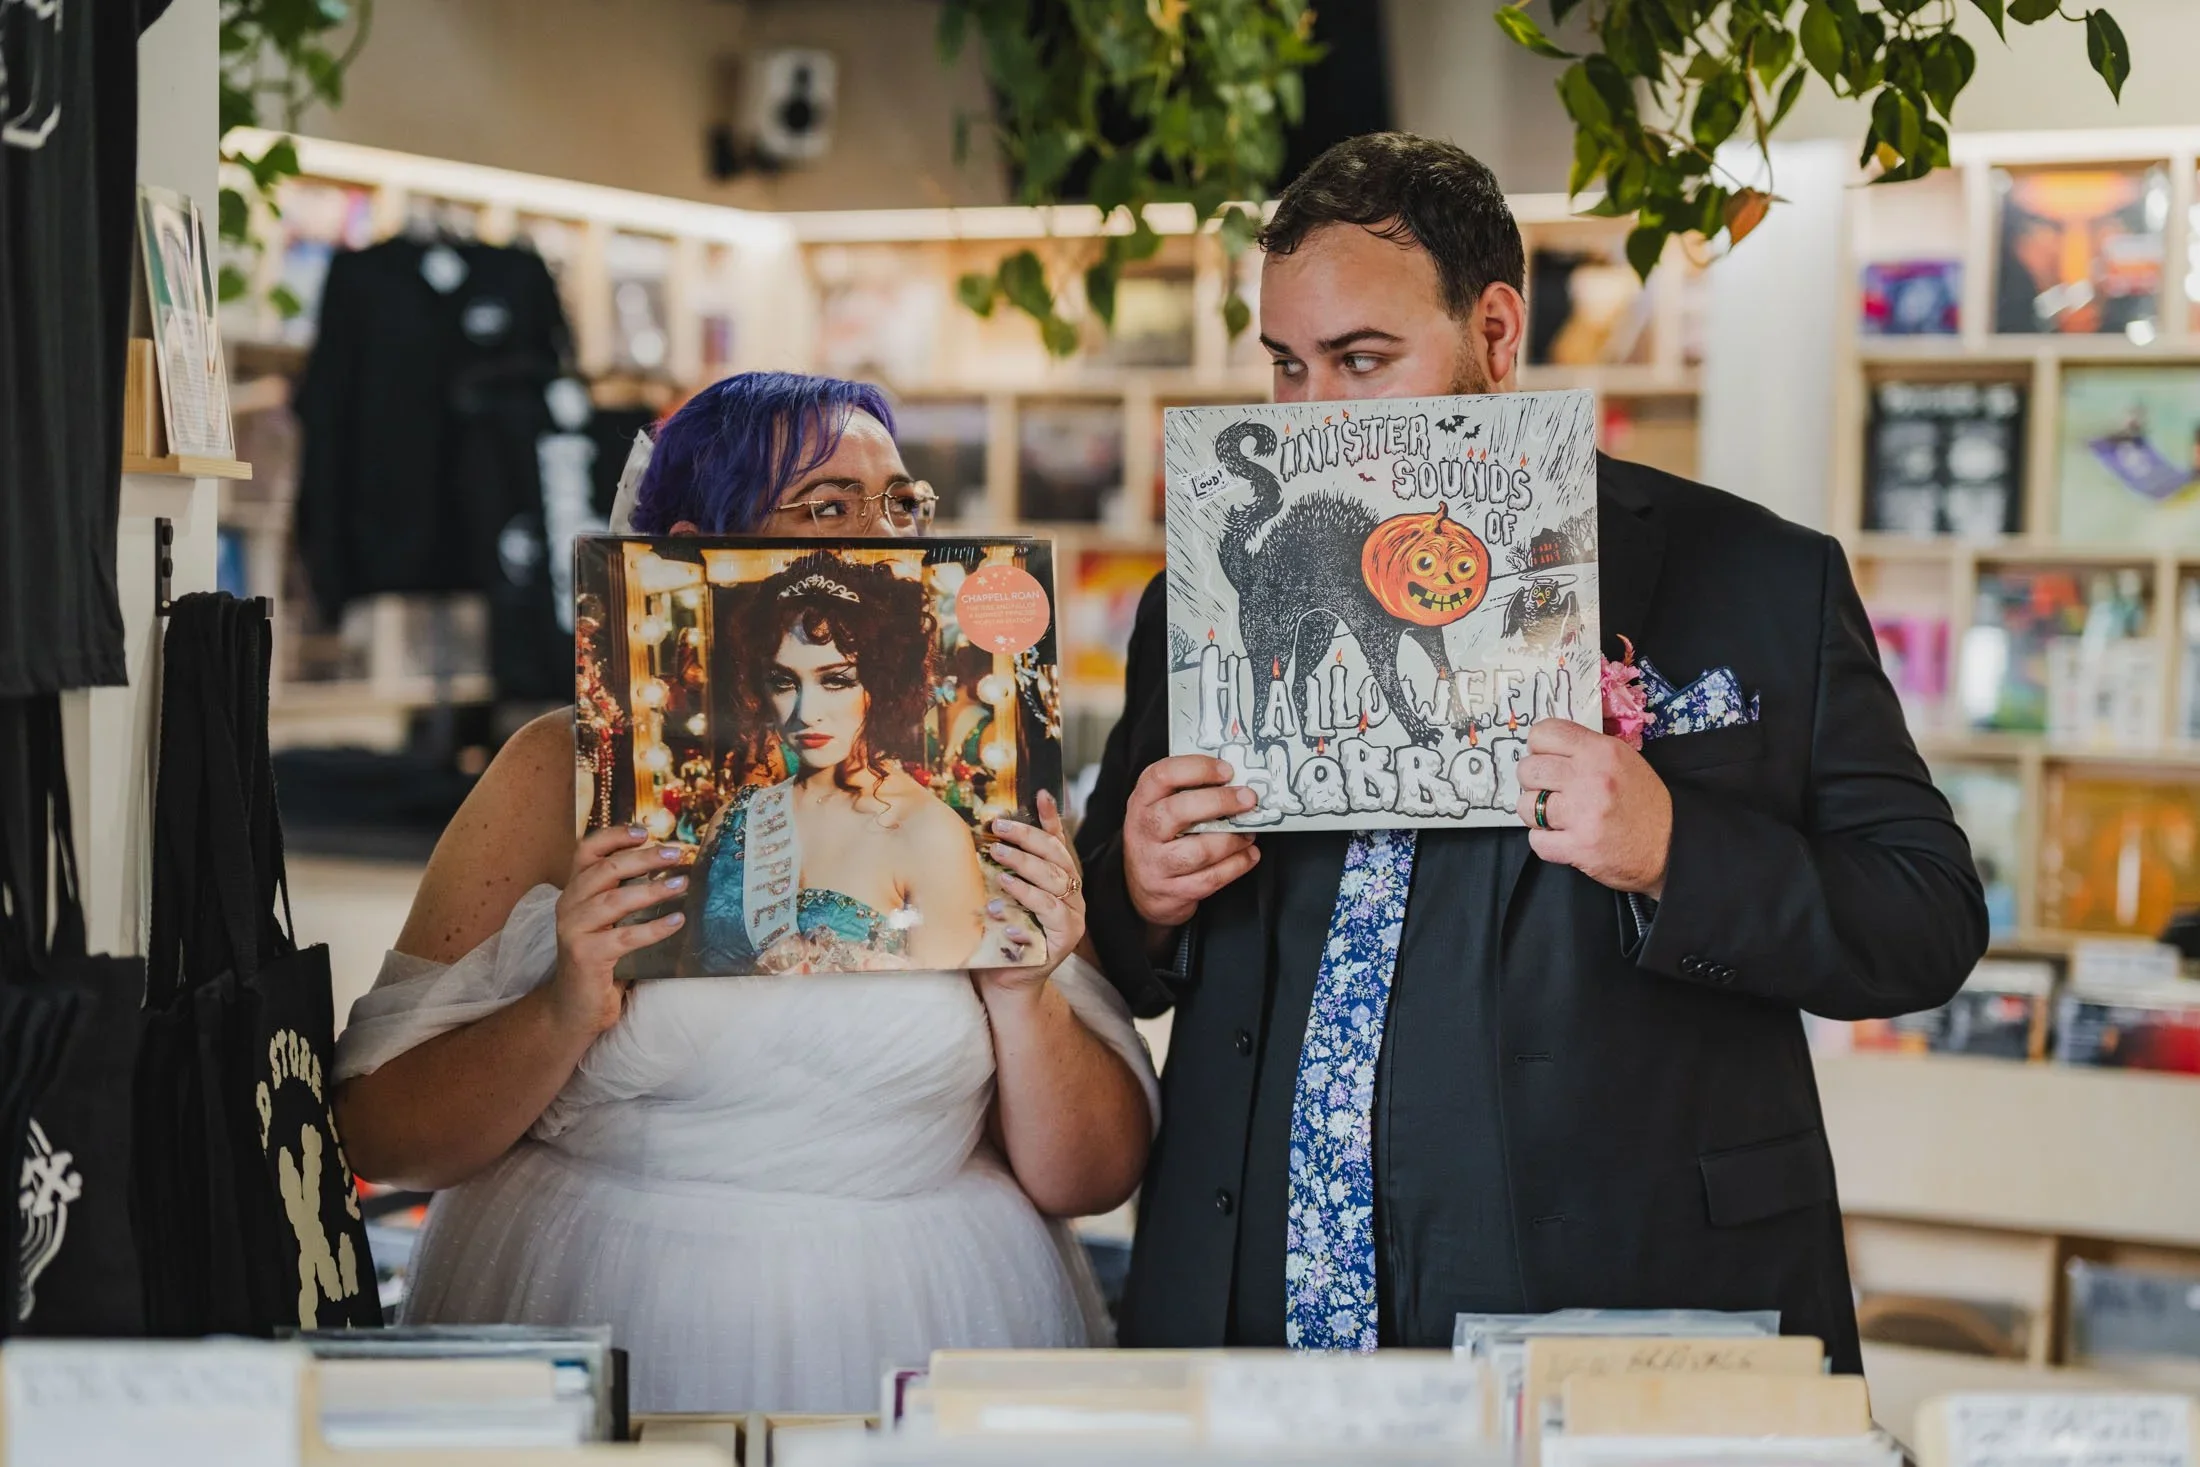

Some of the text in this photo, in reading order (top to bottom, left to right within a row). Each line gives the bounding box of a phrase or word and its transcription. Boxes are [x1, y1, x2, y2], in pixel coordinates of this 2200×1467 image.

[1393, 456, 1533, 512] SOUNDS
[1485, 508, 1517, 546] OF
[961, 590, 1041, 603] CHAPPELL ROAN
[1198, 643, 1575, 750] HALLOWEEN
[268, 1027, 323, 1104] STORE
